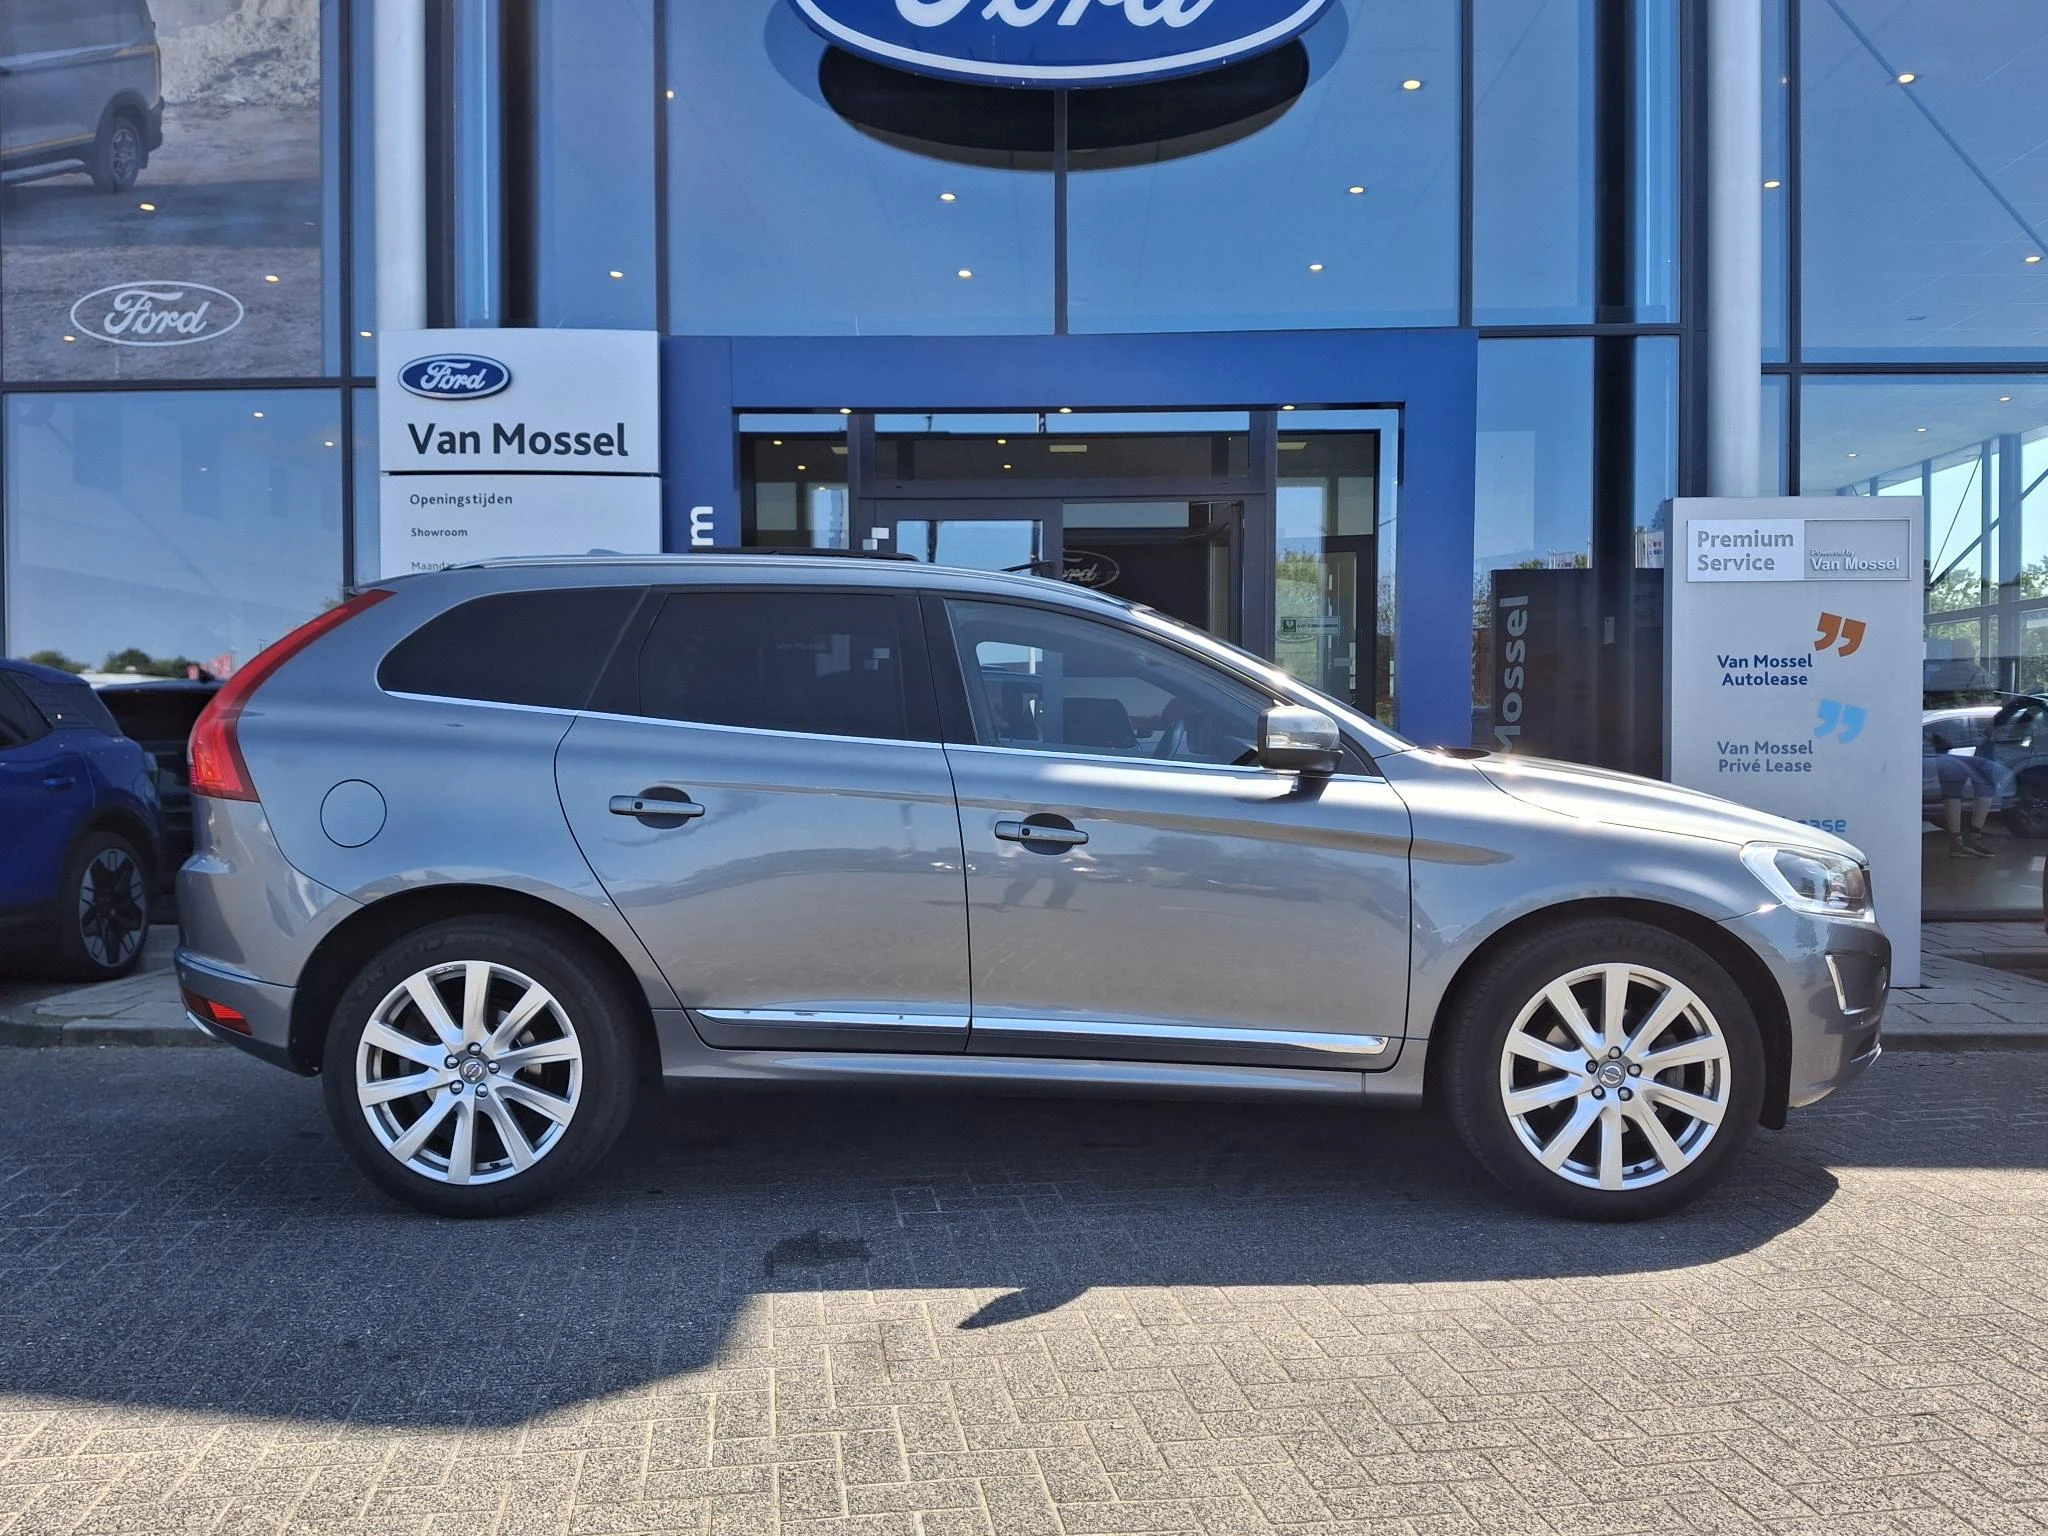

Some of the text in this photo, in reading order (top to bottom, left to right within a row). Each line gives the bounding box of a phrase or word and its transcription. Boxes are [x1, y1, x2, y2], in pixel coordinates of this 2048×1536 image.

[104, 290, 210, 334] Ford
[420, 361, 488, 390] Ford
[407, 422, 629, 456] Van Mossel
[410, 493, 513, 508] Openingstijden
[411, 528, 468, 537] Showroom
[1697, 529, 1794, 548] Premium
[411, 560, 456, 571] Maand
[1697, 553, 1775, 571] Service
[1810, 556, 1901, 571] Van Mossel
[1717, 653, 1813, 668] Van Mossel
[1722, 671, 1808, 686] Autolease
[1717, 740, 1814, 755] Van Mossel
[1719, 758, 1812, 772] Privé Lease
